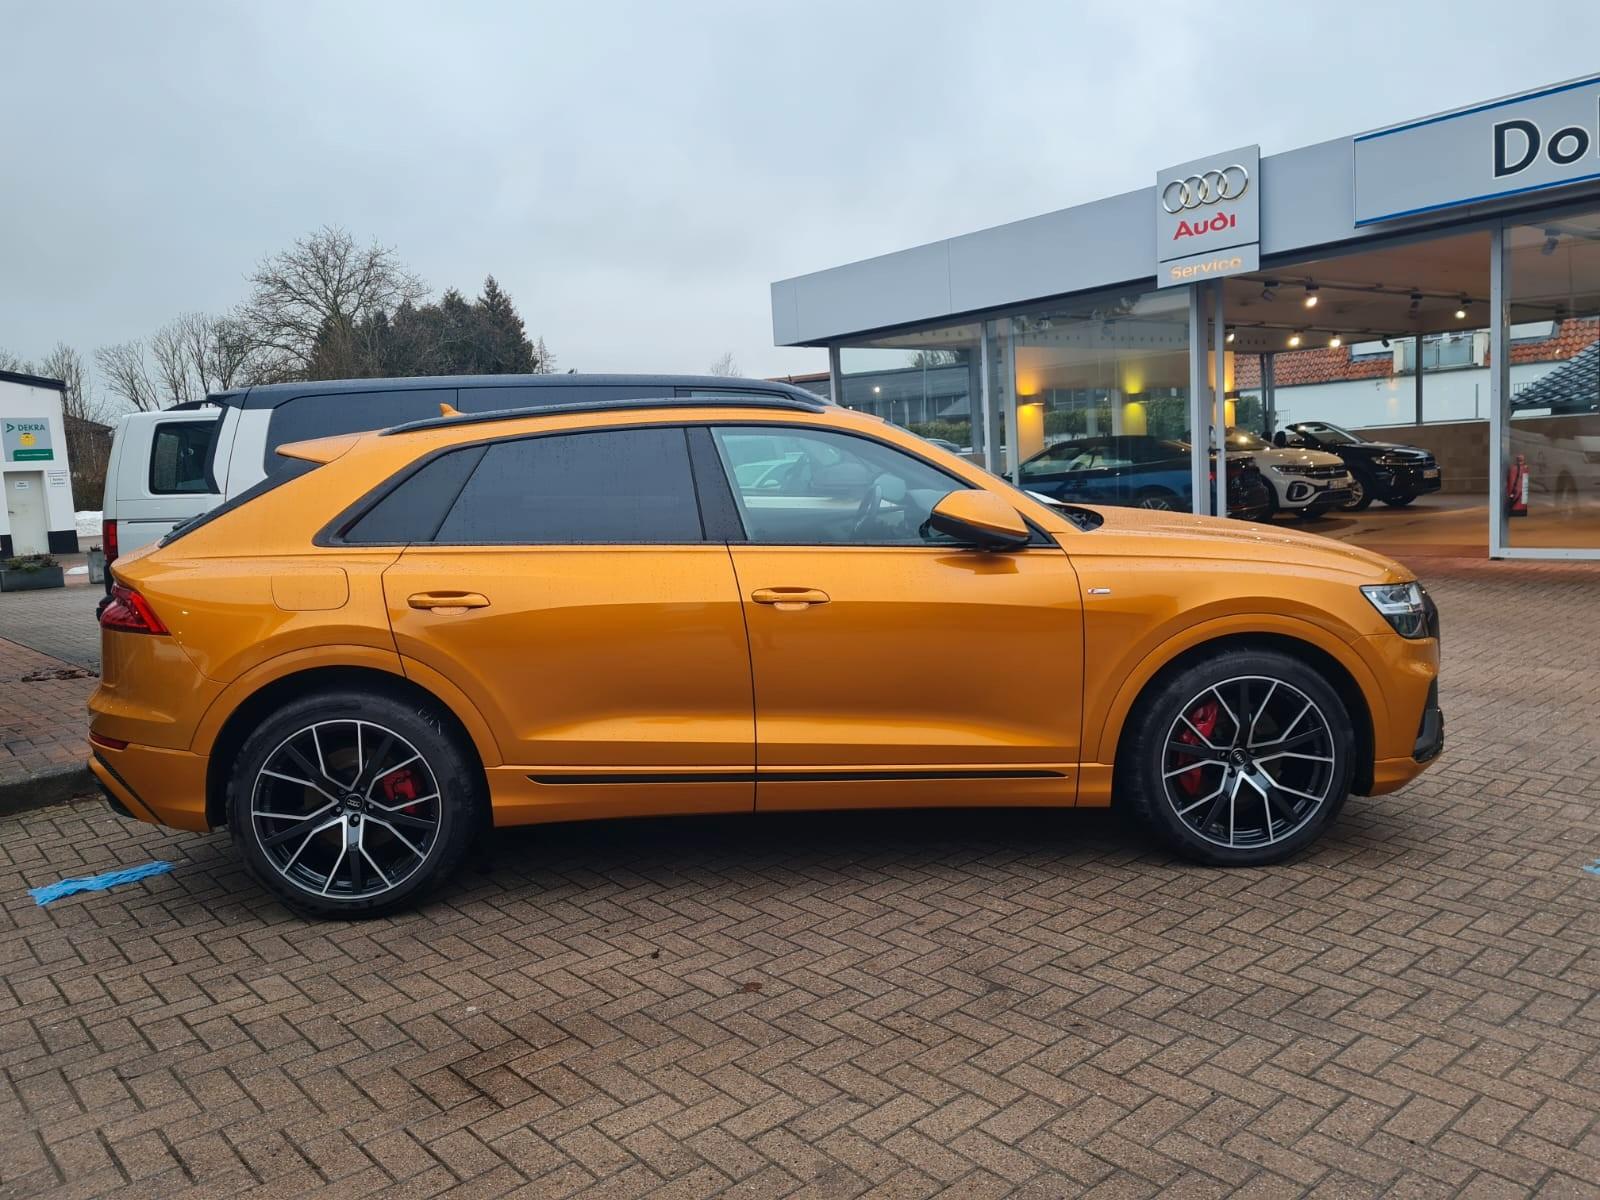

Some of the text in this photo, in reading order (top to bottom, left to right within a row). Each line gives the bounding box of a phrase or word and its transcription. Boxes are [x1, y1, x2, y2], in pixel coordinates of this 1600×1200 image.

[1492, 96, 1600, 180] Do
[1172, 212, 1236, 241] Audi
[1170, 255, 1242, 280] Service
[17, 424, 46, 432] DEKRA
